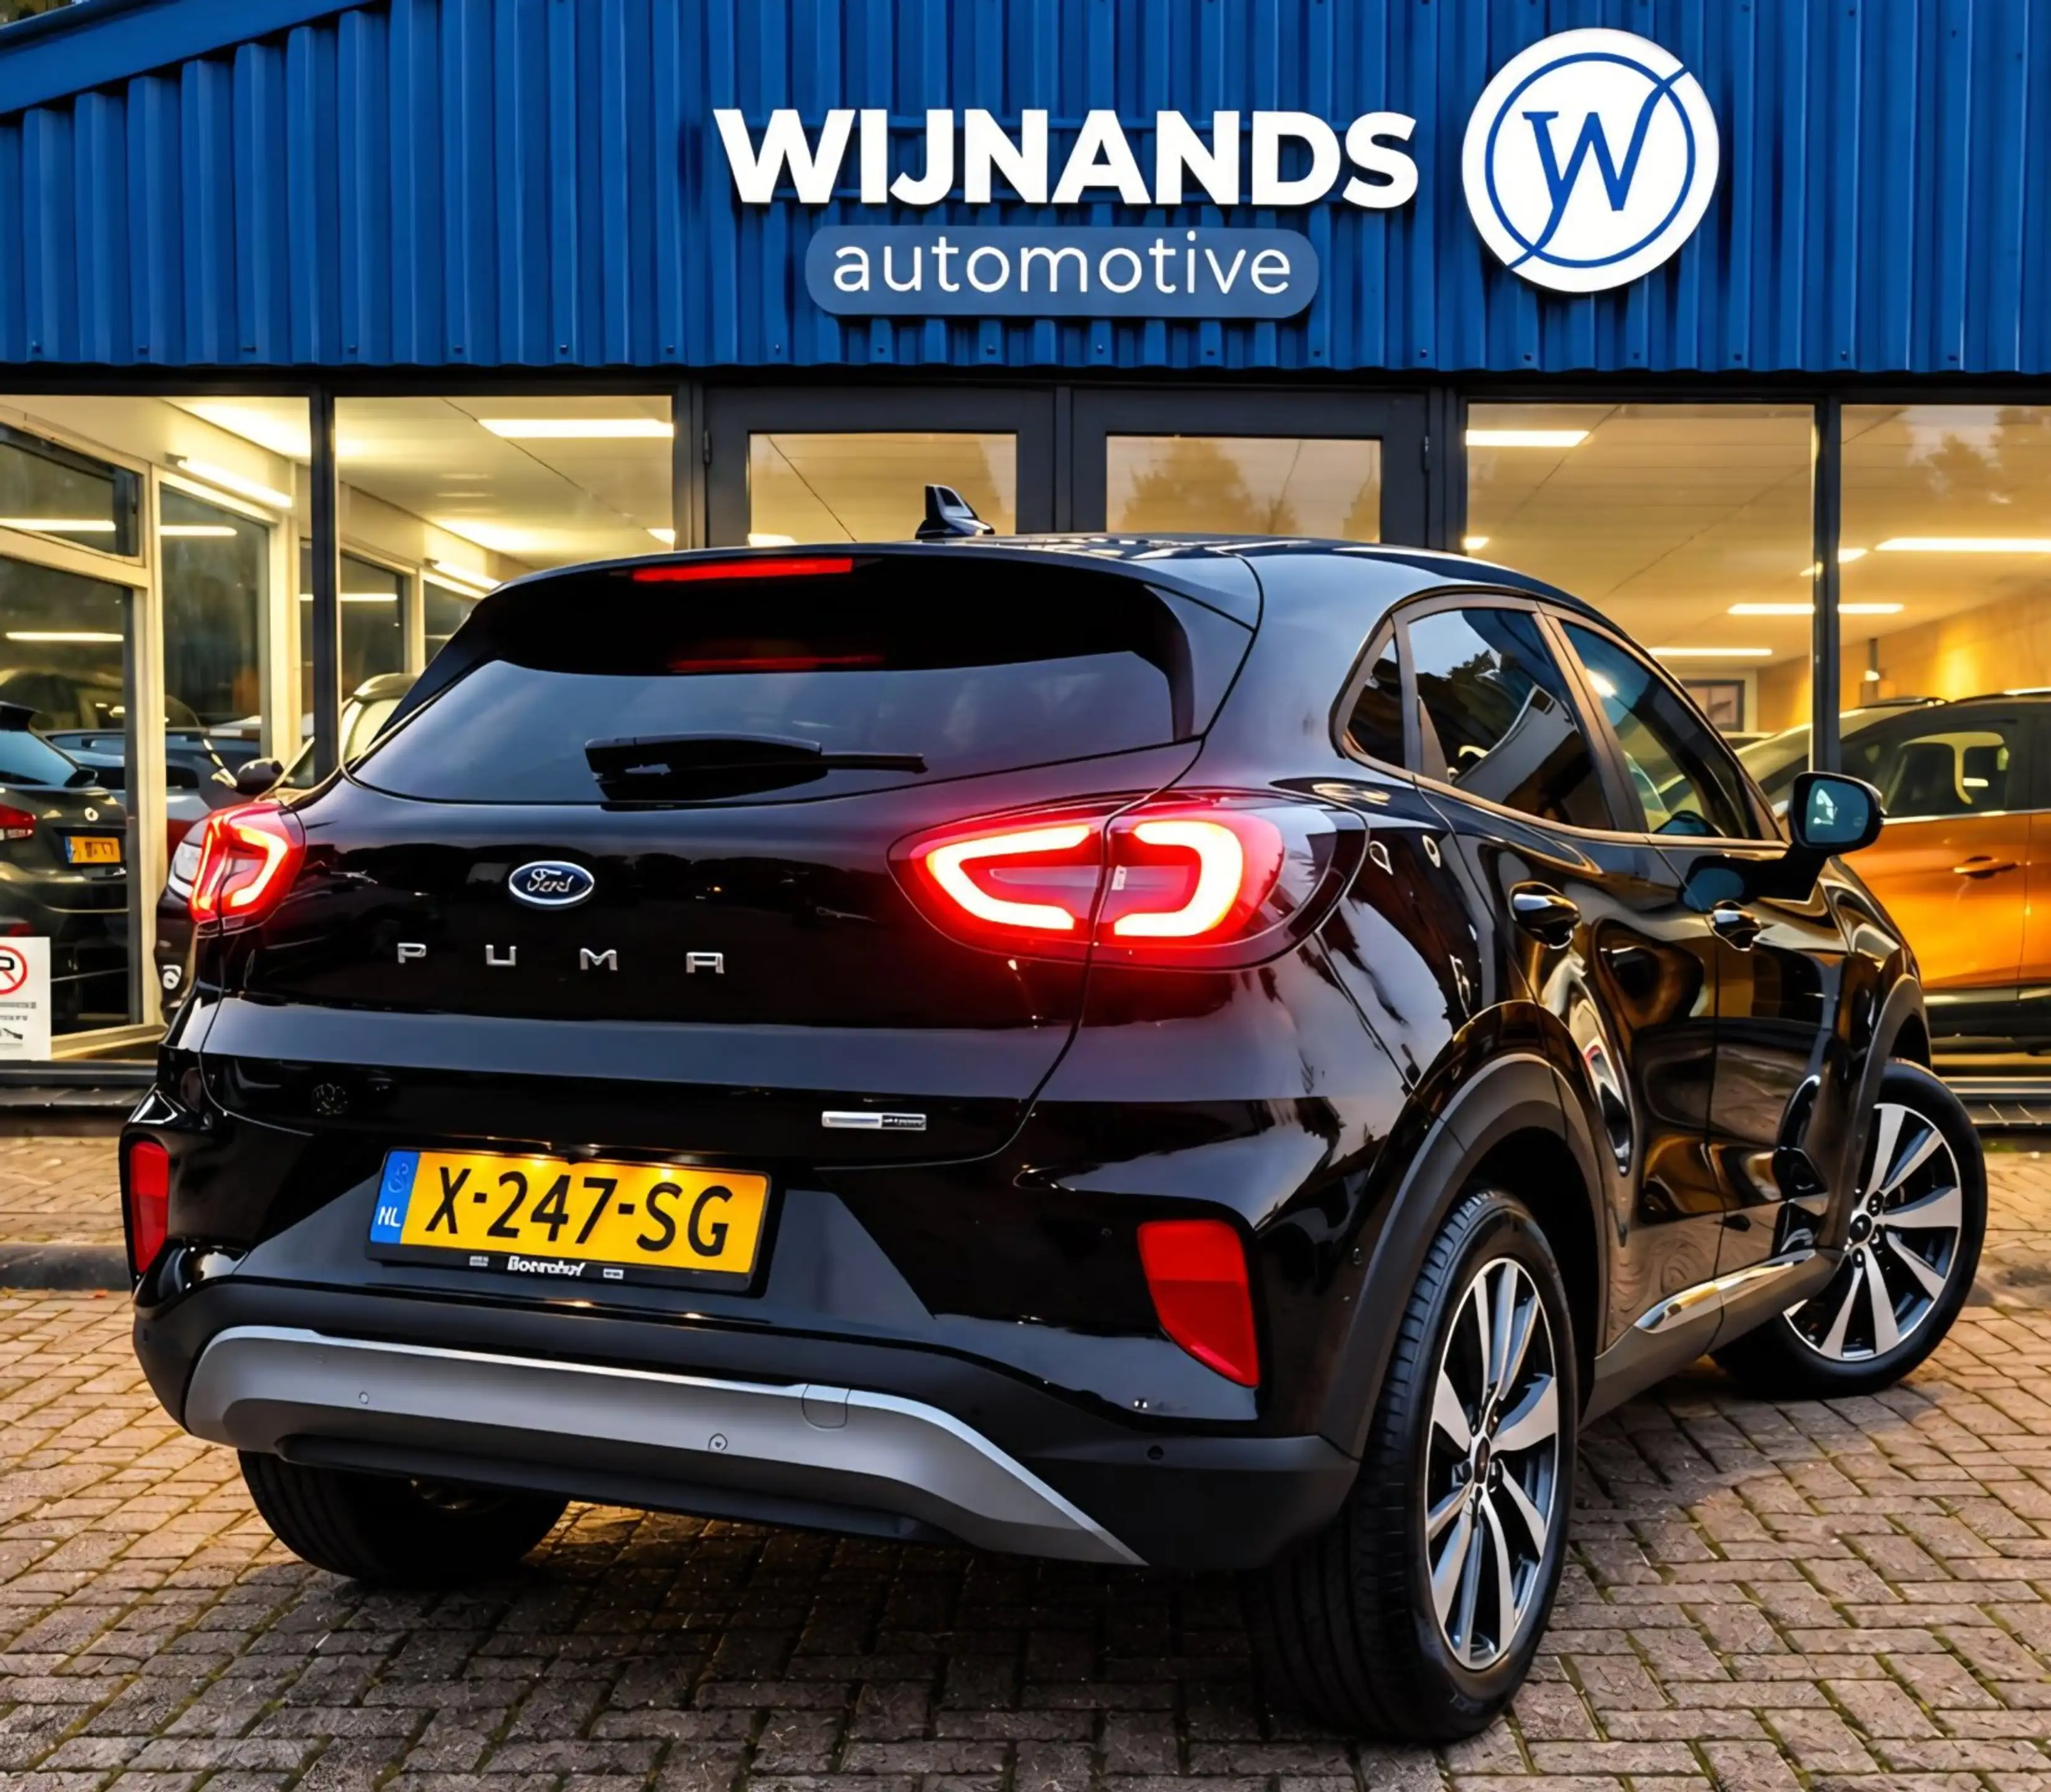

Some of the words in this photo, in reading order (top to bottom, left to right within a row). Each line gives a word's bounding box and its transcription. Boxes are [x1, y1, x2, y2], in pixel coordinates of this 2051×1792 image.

[712, 108, 1419, 209] WIJNANDS
[833, 231, 1291, 296] automotive
[526, 868, 574, 892] Ford
[378, 1206, 401, 1228] NL
[425, 1167, 733, 1257] X-247-SG
